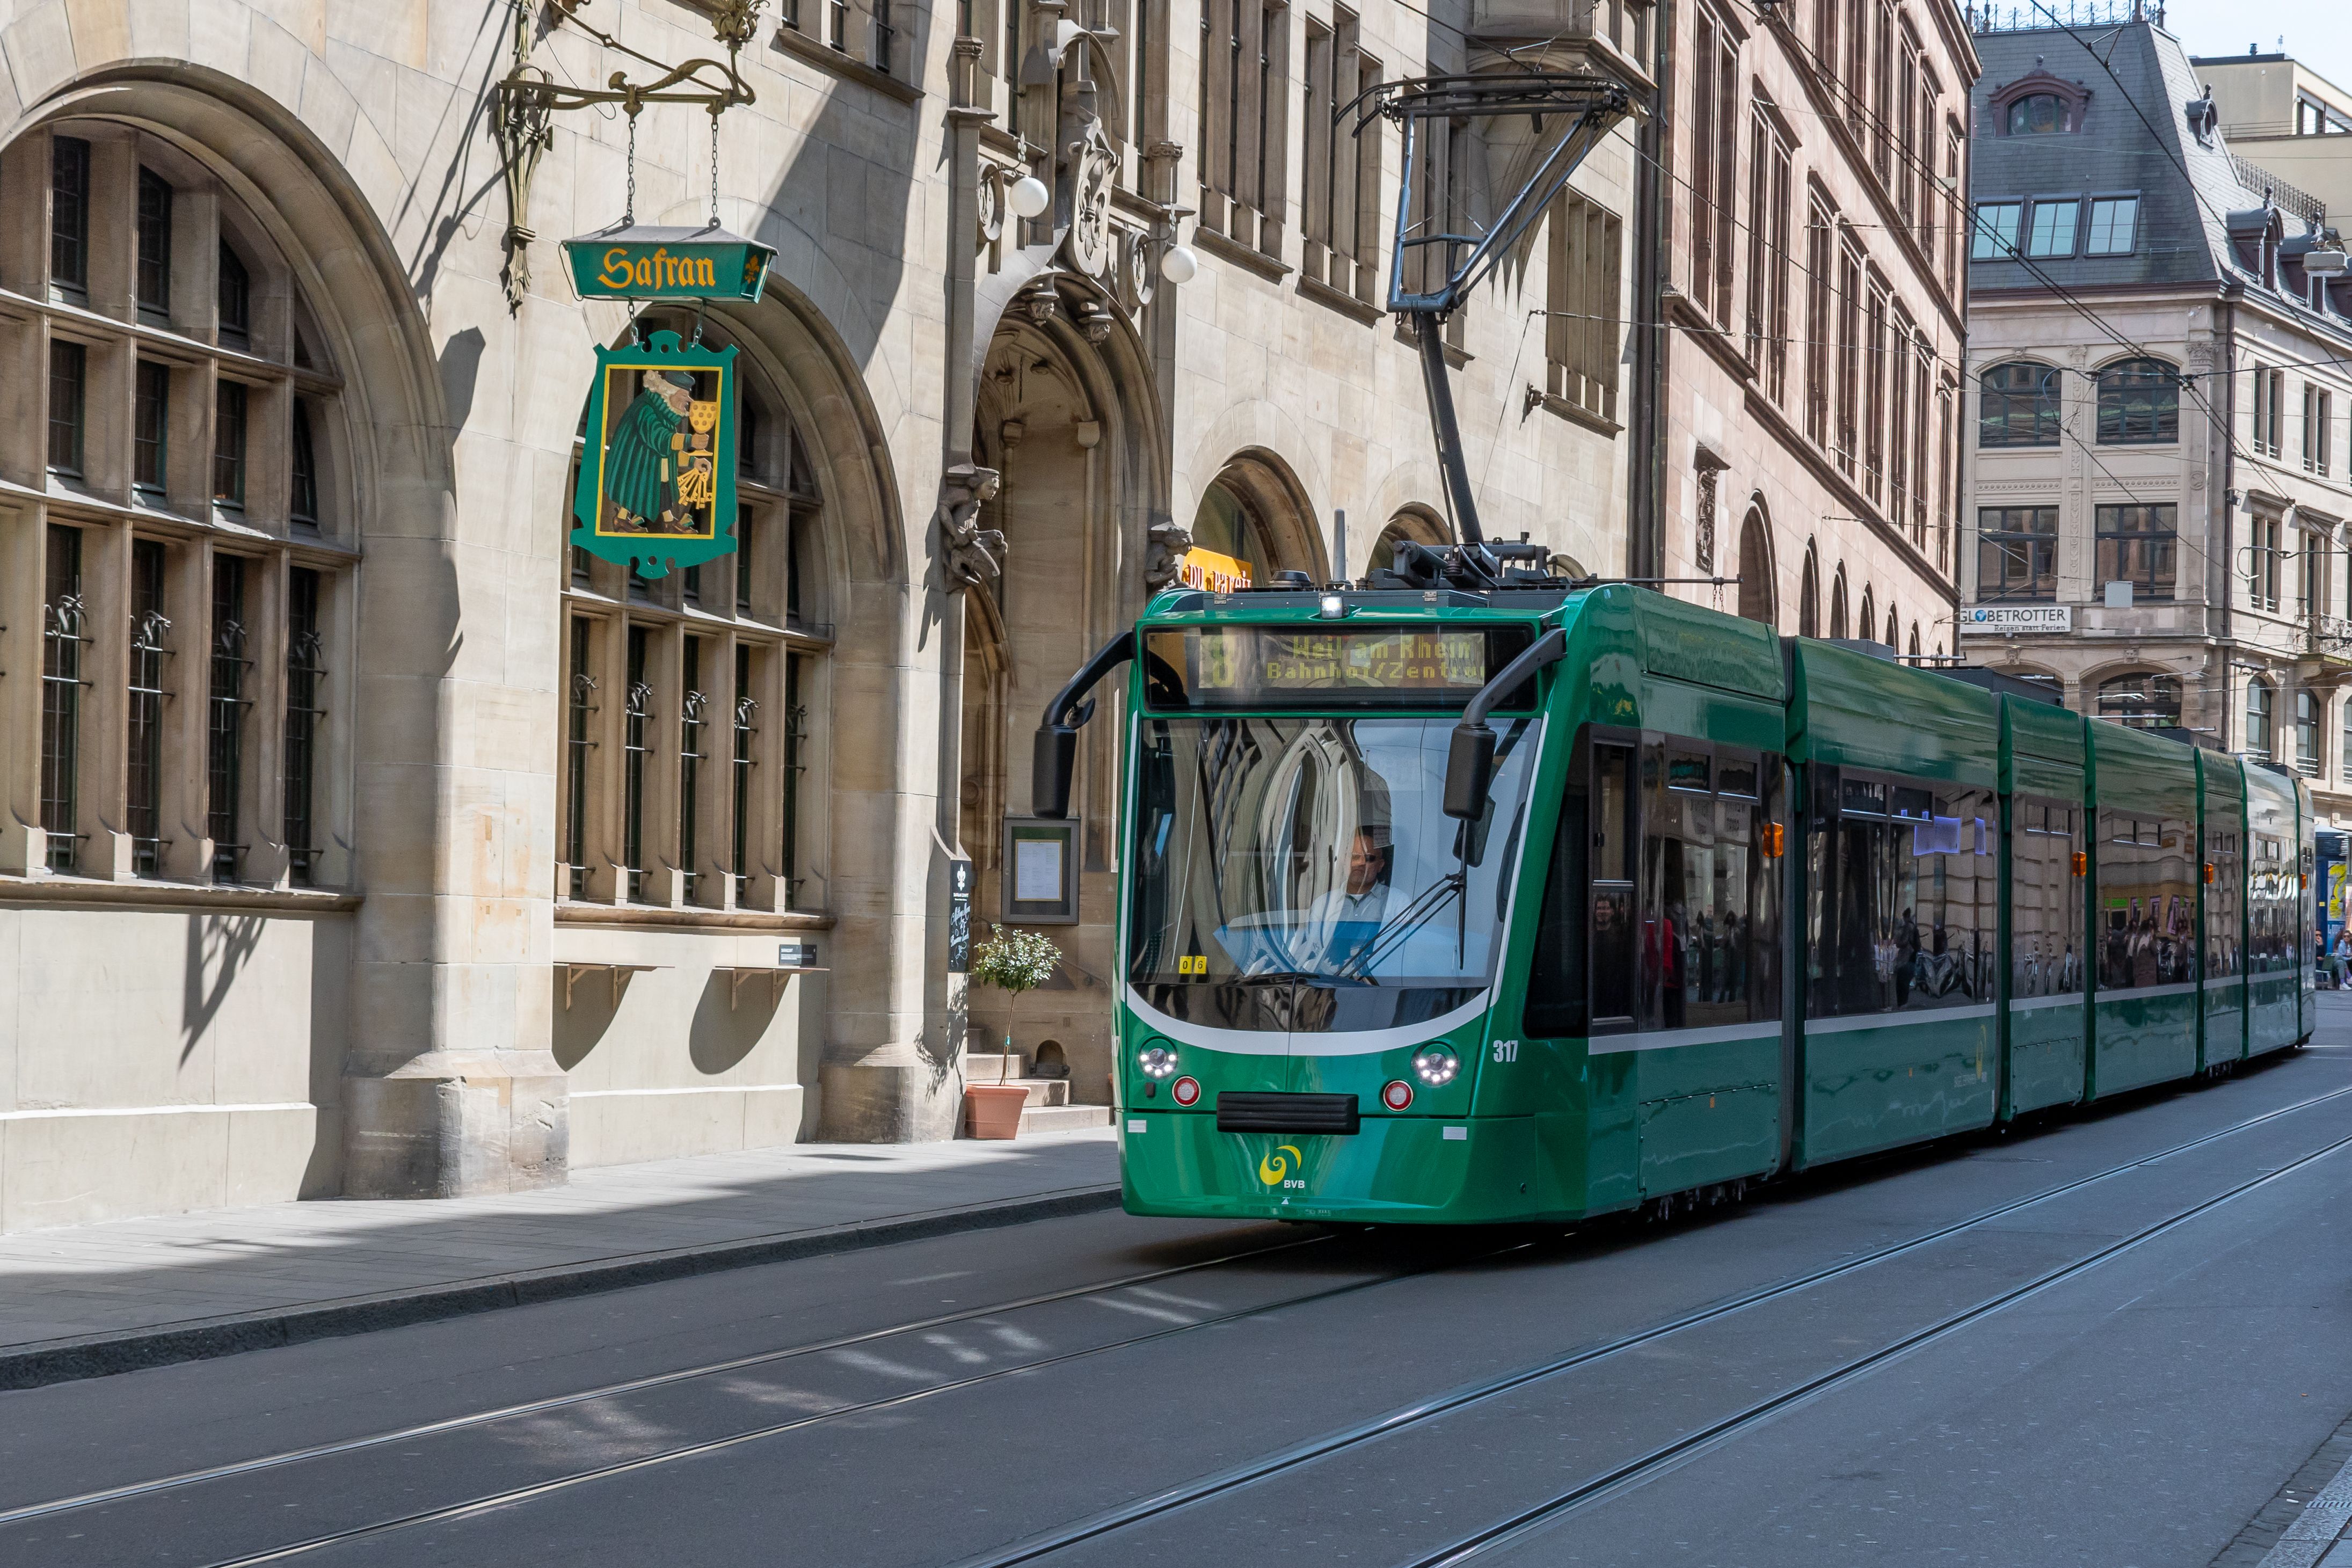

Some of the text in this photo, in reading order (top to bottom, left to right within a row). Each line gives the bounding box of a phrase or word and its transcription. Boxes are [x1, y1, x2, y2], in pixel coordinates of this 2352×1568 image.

[597, 247, 716, 290] Safran
[1960, 609, 2066, 622] GLOBETROTTER
[1355, 642, 1388, 659] am
[1400, 635, 1471, 659] Rhein
[1493, 1039, 1518, 1062] 317
[1284, 1179, 1305, 1188] BVB
